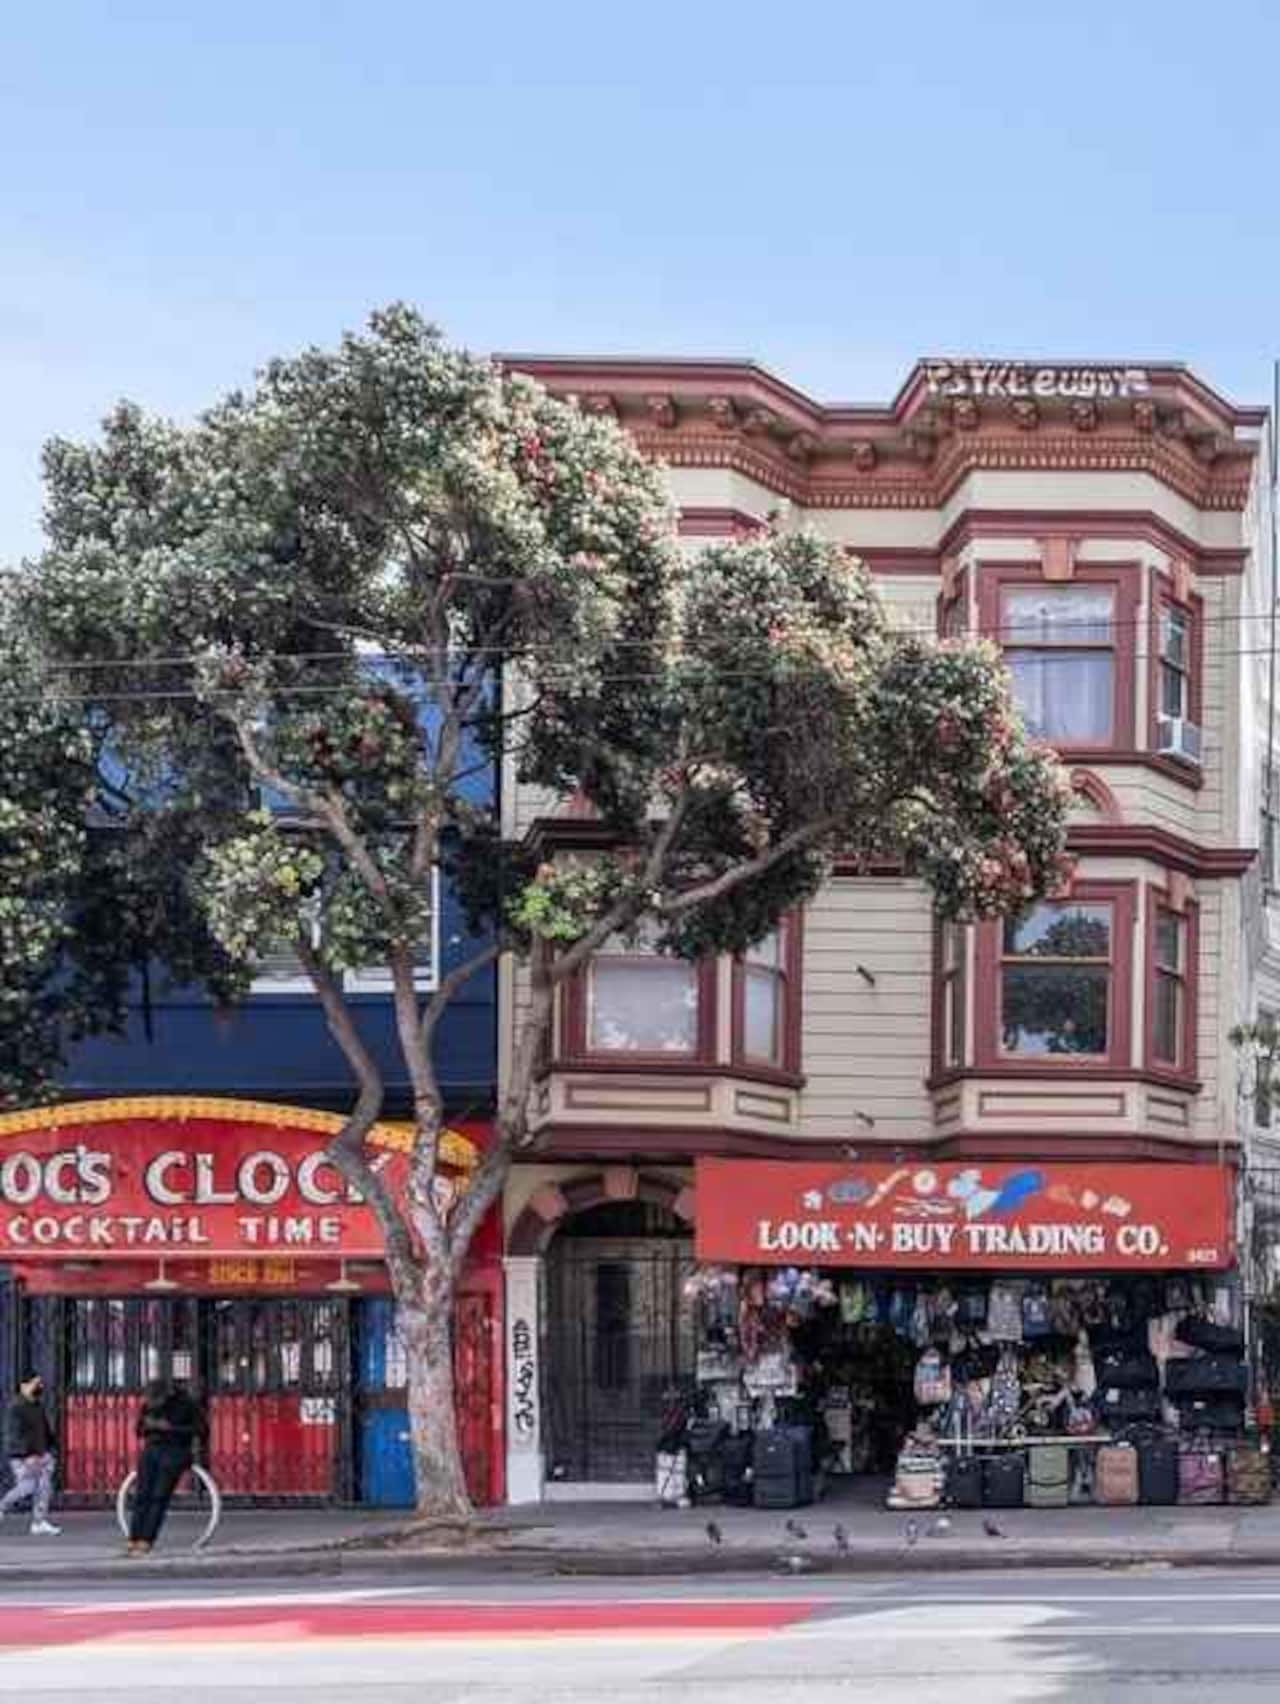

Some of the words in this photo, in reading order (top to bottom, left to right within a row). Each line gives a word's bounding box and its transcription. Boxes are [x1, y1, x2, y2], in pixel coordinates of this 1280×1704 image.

[146, 1150, 393, 1205] CLOC
[238, 1216, 342, 1245] TIME
[758, 1220, 842, 1252] LOOK
[893, 1222, 955, 1254] BUY
[960, 1223, 1105, 1256] TRADING
[1115, 1225, 1170, 1257] CO.
